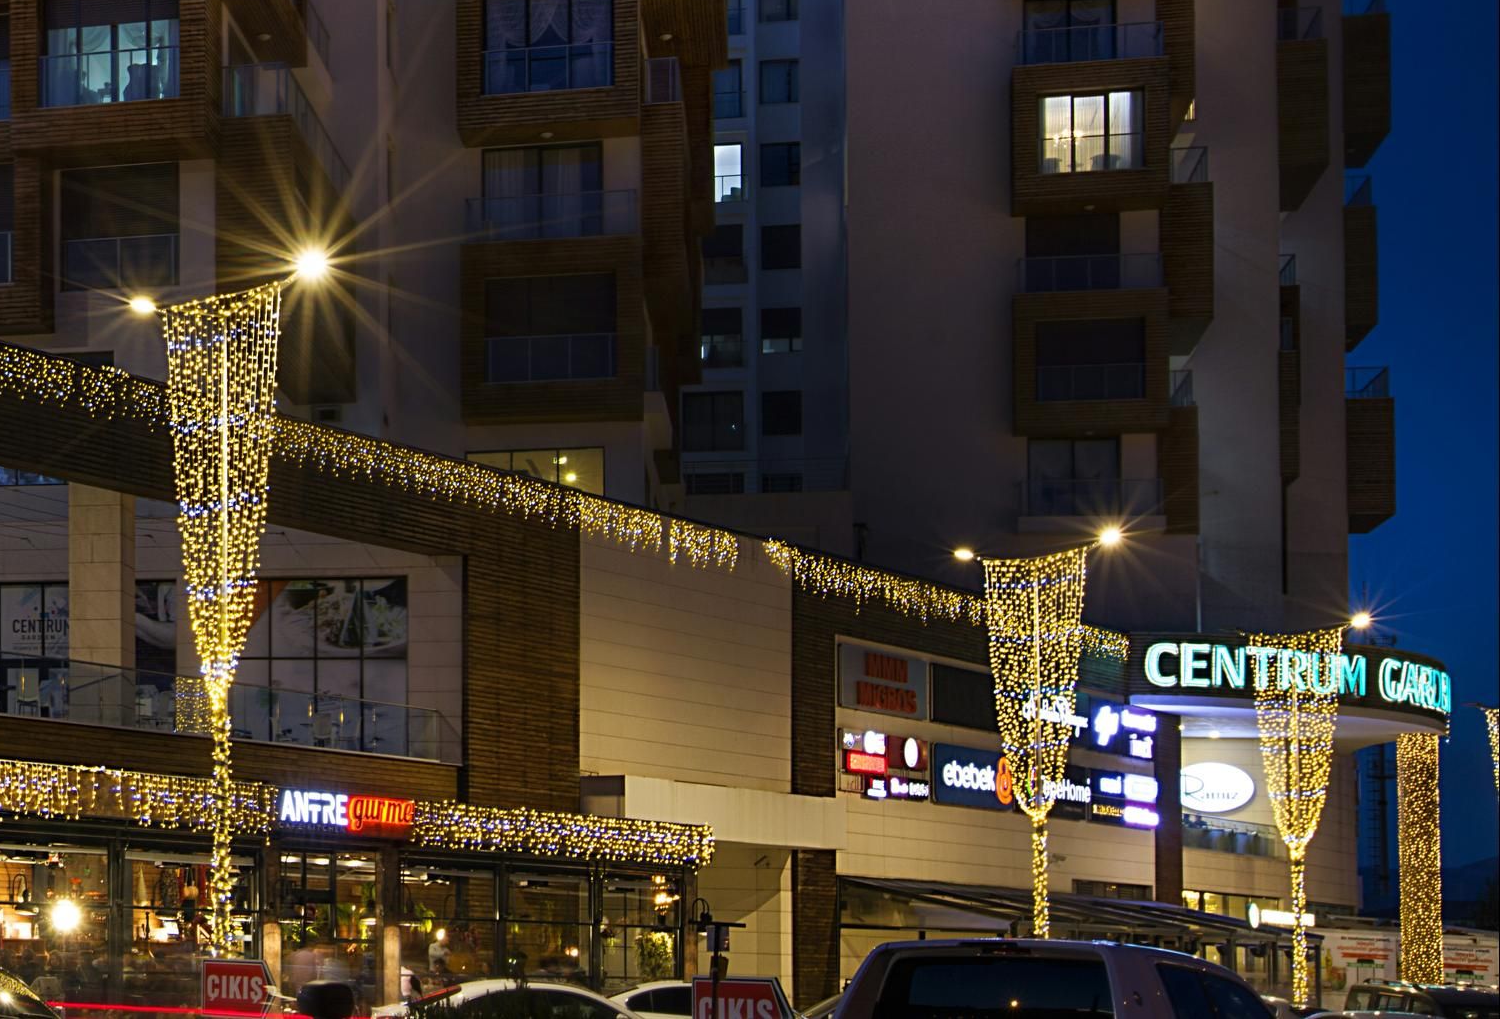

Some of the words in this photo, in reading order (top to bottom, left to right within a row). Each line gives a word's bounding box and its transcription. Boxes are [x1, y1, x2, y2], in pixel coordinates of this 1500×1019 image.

[1145, 643, 1367, 696] CENTRUM
[857, 680, 916, 715] MIGROS
[943, 760, 996, 792] ebebek
[280, 790, 349, 825] ANTRE
[352, 797, 415, 831] gurme
[207, 974, 264, 1004] ÇIKIŞ
